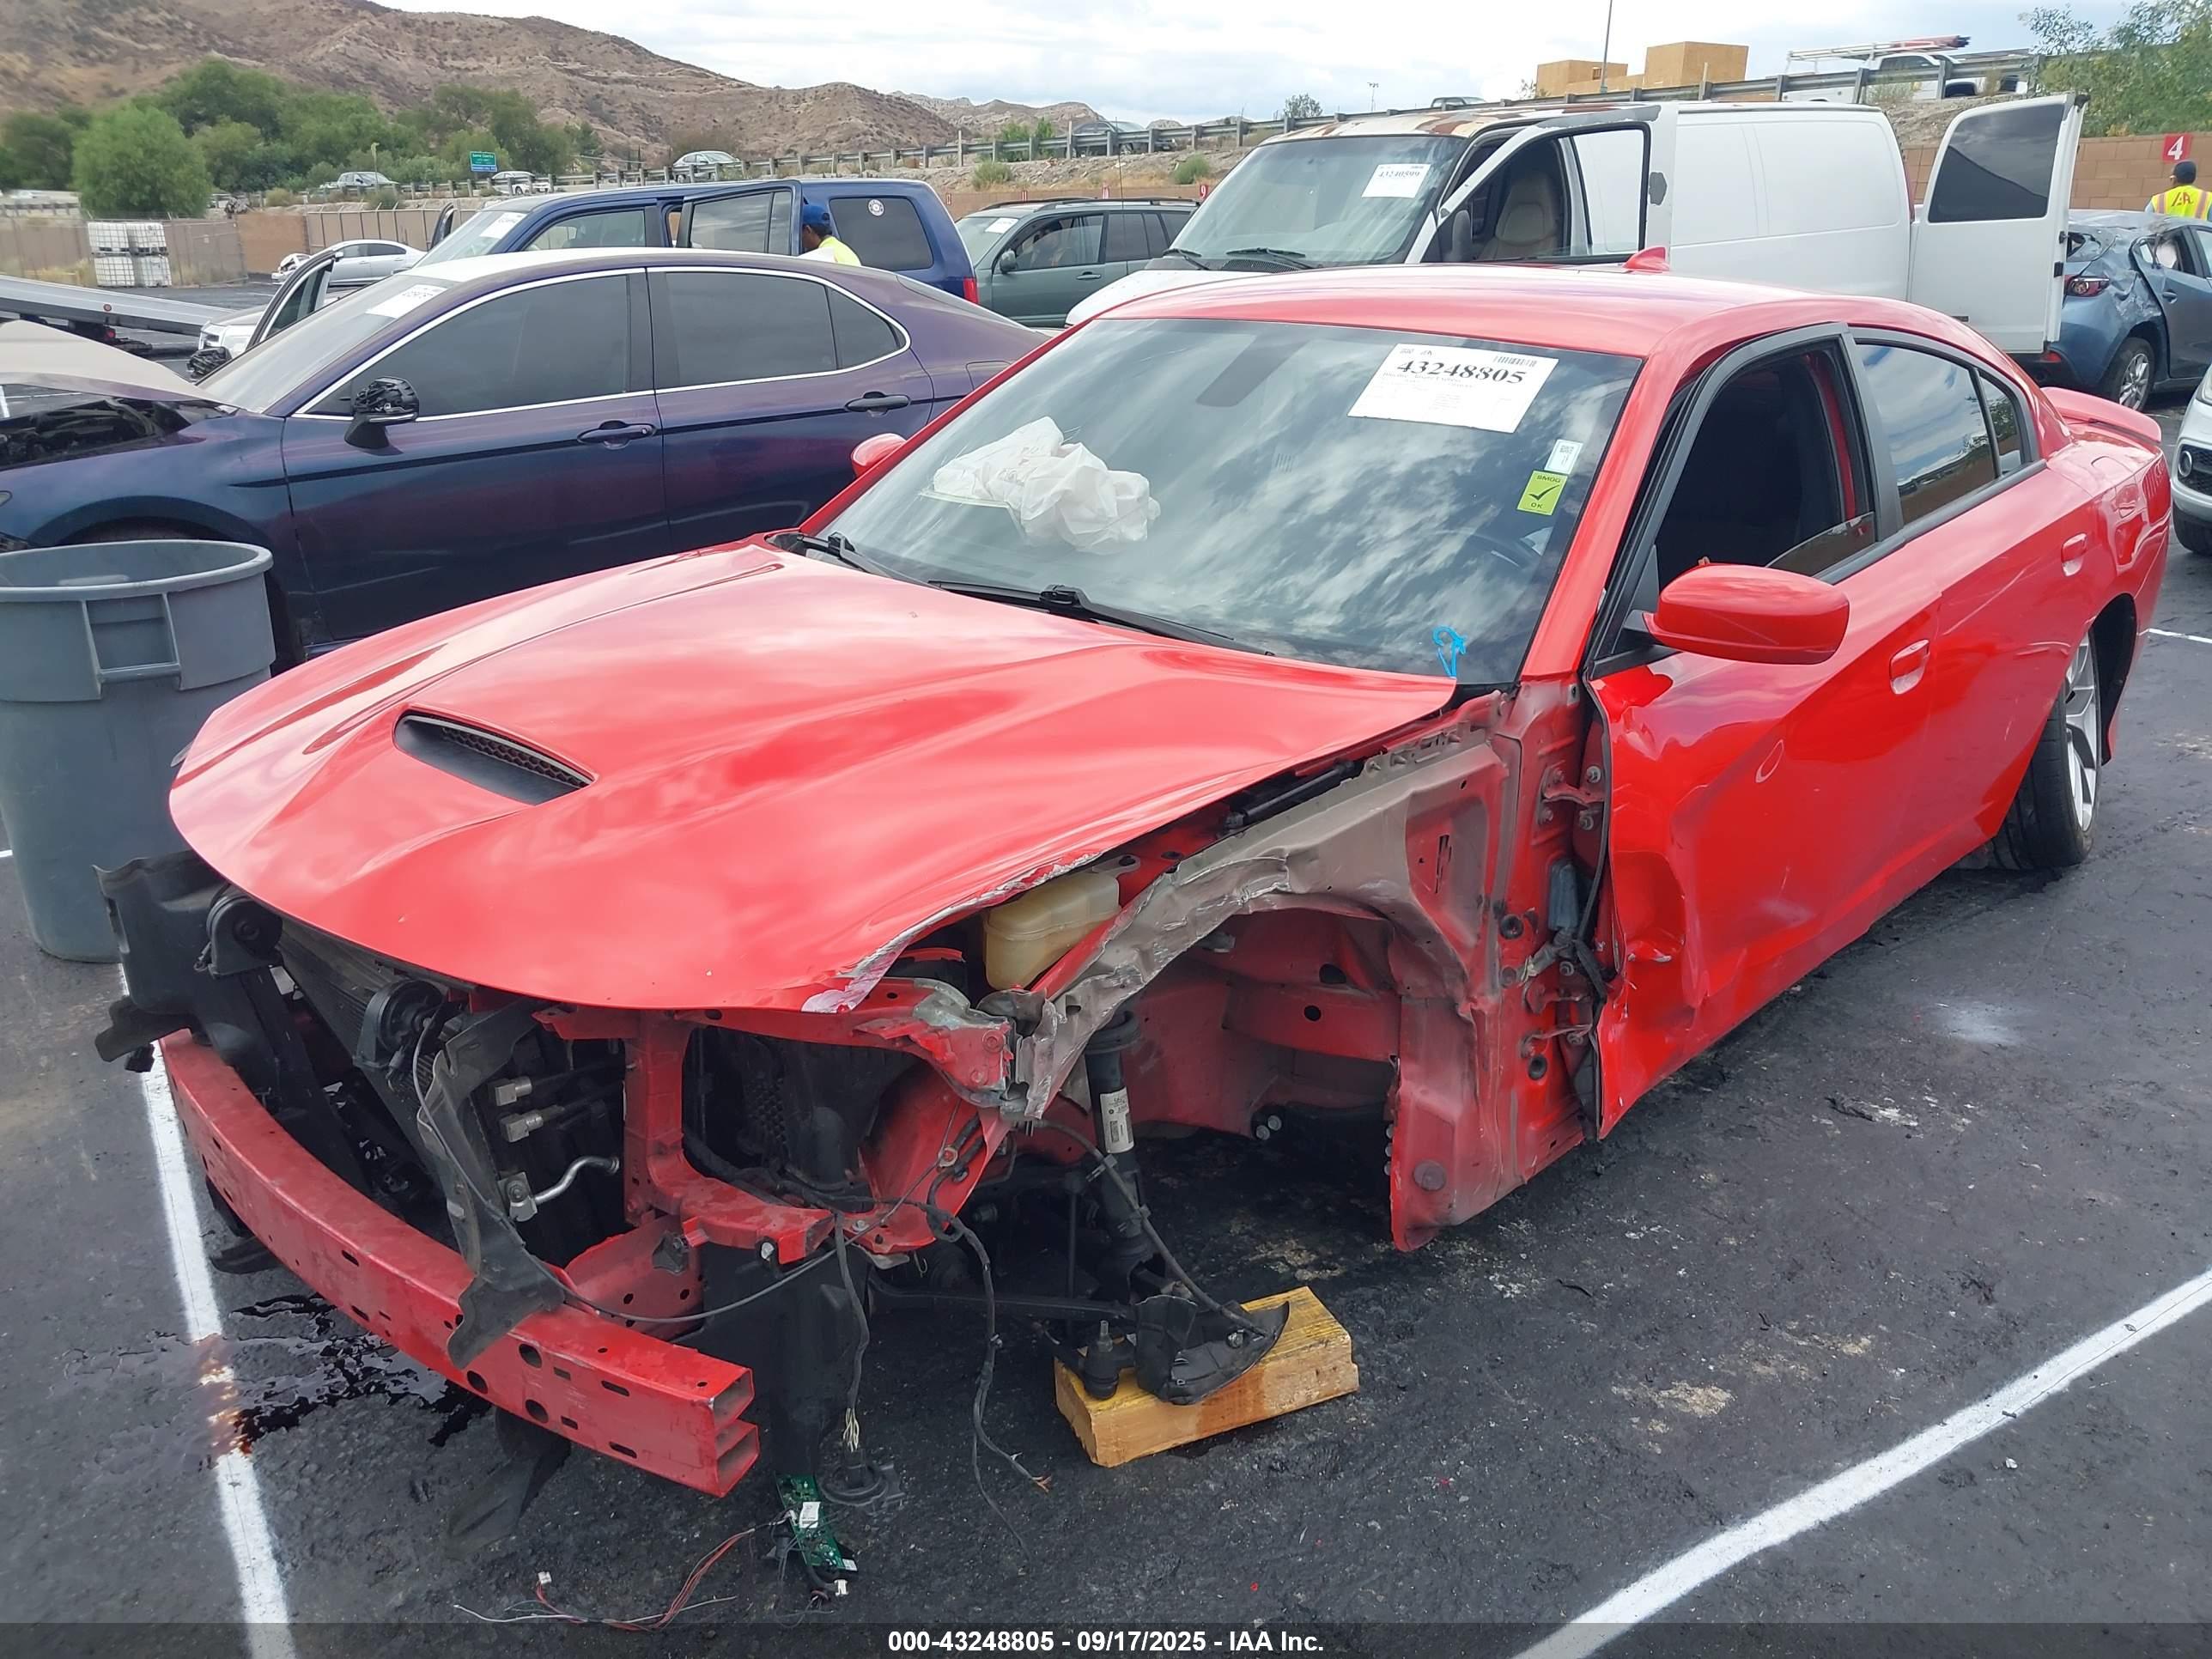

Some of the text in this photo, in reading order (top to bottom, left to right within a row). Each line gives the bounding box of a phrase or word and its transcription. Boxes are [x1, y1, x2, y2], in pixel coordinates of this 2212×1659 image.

[2166, 136, 2185, 161] 4
[1200, 185, 1206, 198] 9
[1397, 360, 1527, 385] 43248805
